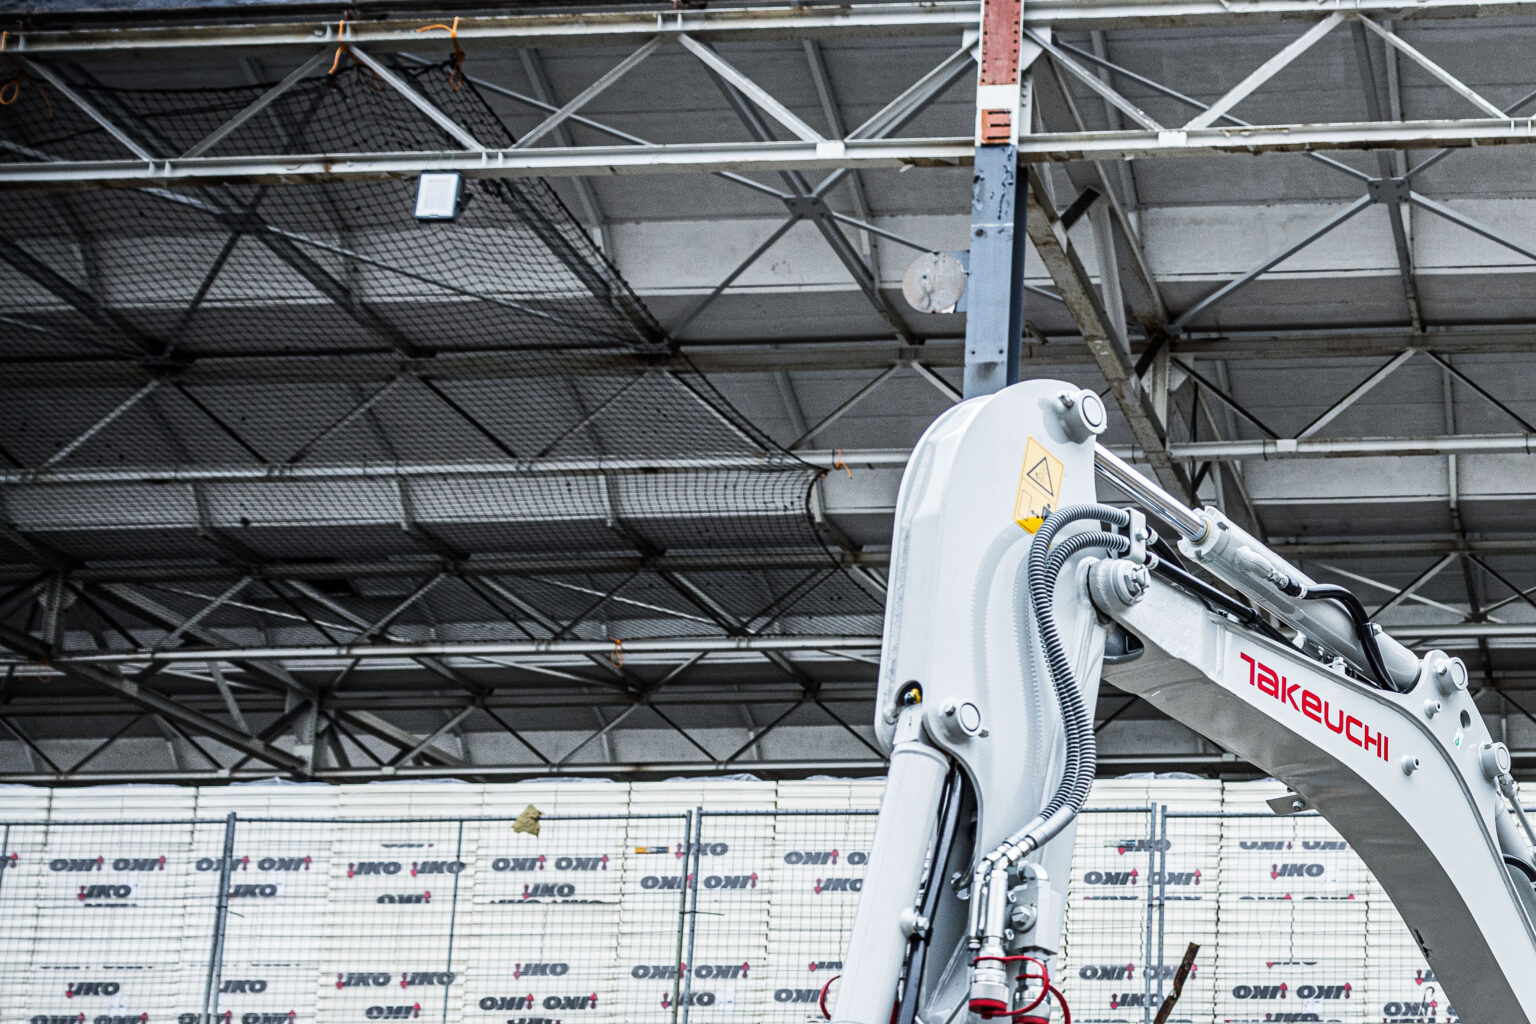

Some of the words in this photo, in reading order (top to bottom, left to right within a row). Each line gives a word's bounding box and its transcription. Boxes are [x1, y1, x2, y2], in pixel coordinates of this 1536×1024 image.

[491, 857, 540, 871] IKO
[555, 857, 603, 871] IKO
[784, 852, 832, 865] IKO
[353, 861, 402, 875] IKO
[1277, 864, 1325, 877] IKO
[704, 875, 751, 889] IKO
[1084, 871, 1131, 885] IKO
[529, 884, 575, 897] IKO
[521, 963, 569, 976] IKO
[694, 965, 742, 979] IKO
[1079, 965, 1127, 980] IKO
[343, 972, 391, 986] IKO
[1232, 985, 1280, 999] IKO
[1296, 985, 1344, 999] IKO
[479, 997, 527, 1010] IKO
[543, 996, 591, 1010] IKO
